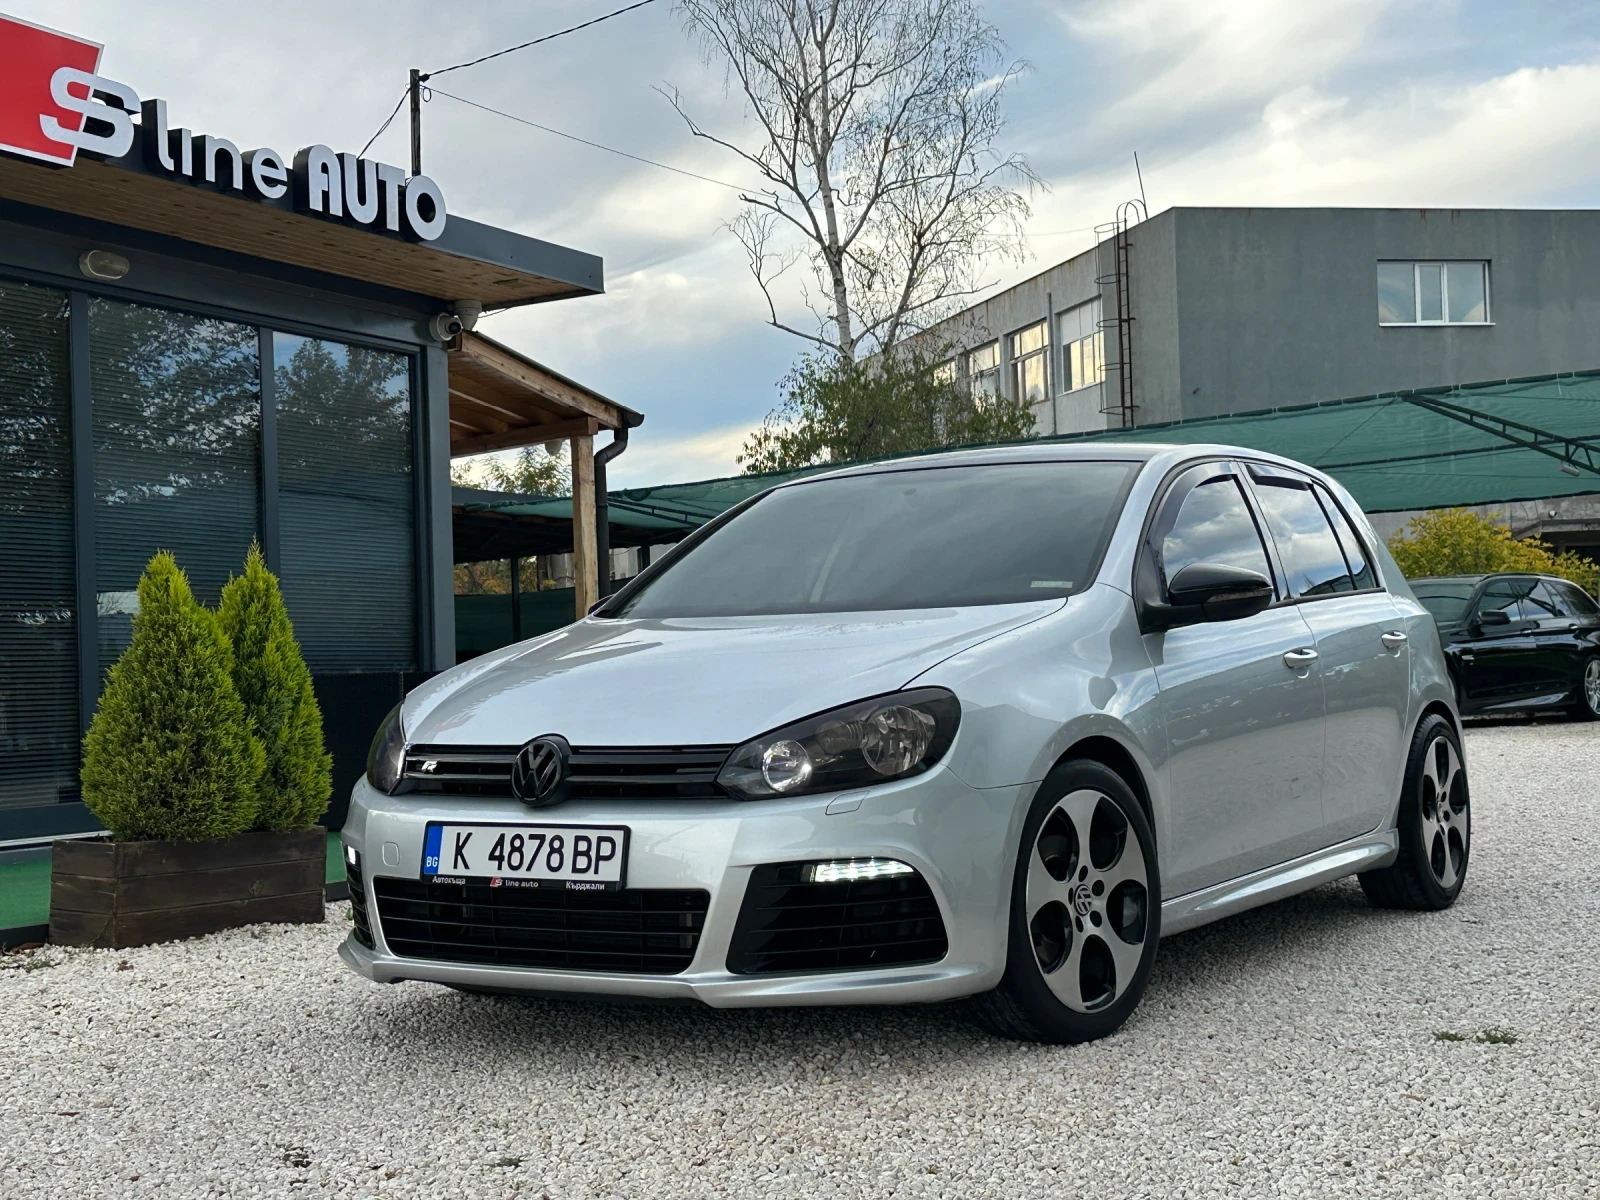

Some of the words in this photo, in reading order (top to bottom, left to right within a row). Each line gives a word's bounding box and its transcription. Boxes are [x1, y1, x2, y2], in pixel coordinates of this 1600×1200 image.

[39, 66, 142, 158] S
[155, 98, 288, 200] line
[305, 143, 447, 241] AUTO
[452, 832, 473, 870] K
[426, 856, 438, 868] BG
[505, 879, 520, 888] line
[521, 881, 539, 889] auto
[565, 880, 606, 891] Кърджали
